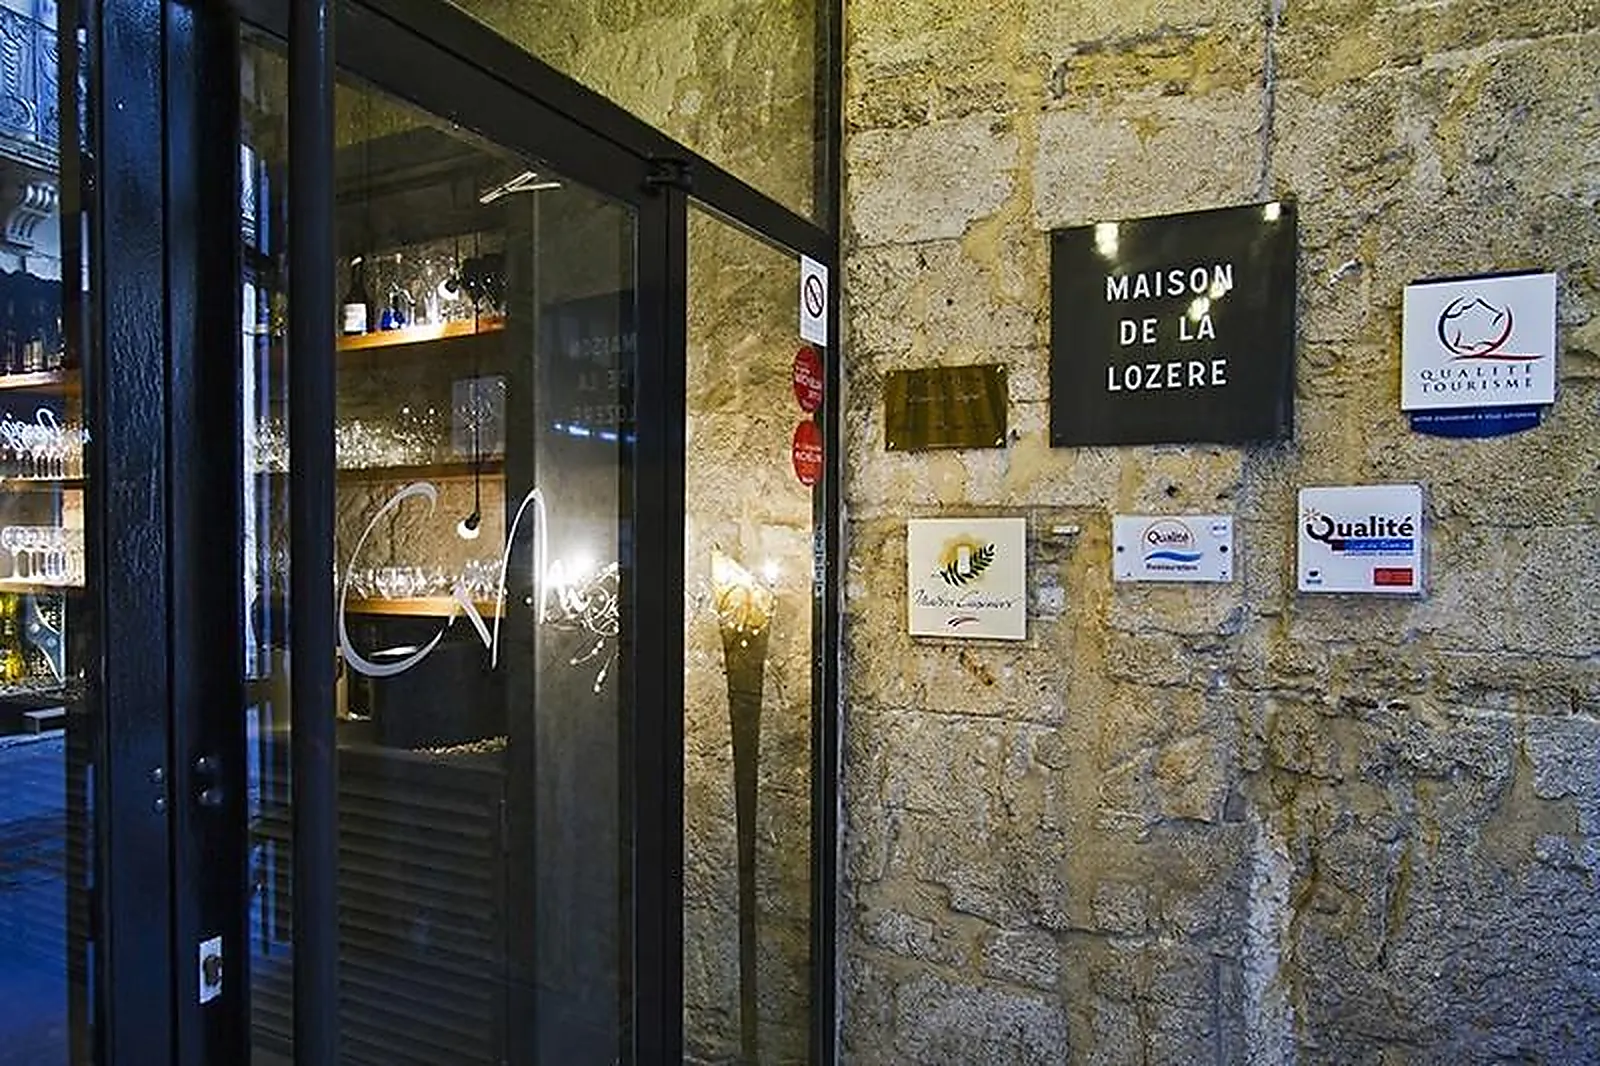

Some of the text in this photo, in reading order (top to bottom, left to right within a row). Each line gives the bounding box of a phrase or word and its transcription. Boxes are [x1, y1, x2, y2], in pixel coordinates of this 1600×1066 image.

[1106, 264, 1233, 302] MAISON
[1120, 315, 1216, 345] DE LA
[1107, 359, 1228, 391] LOZERE
[1421, 378, 1534, 393] TOURISME
[1306, 515, 1414, 544] Qualité
